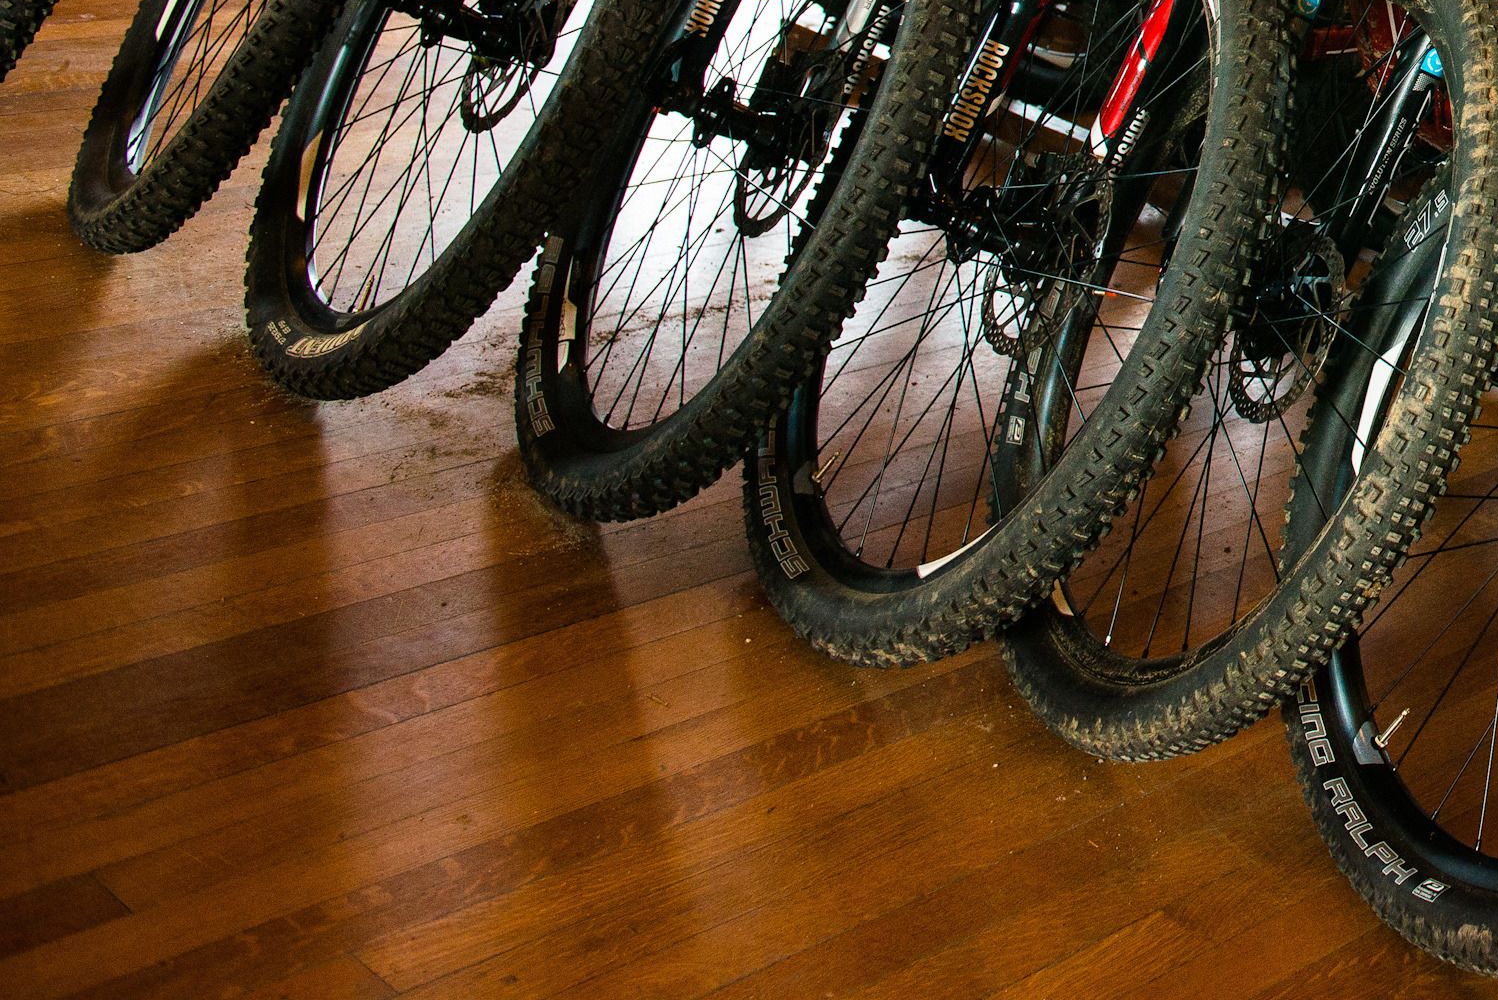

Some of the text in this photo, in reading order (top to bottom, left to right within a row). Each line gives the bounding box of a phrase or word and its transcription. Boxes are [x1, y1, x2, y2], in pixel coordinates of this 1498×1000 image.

[944, 39, 1010, 143] ROCKSHOX
[1404, 189, 1449, 253] 27.5
[1323, 776, 1418, 886] RALPH
